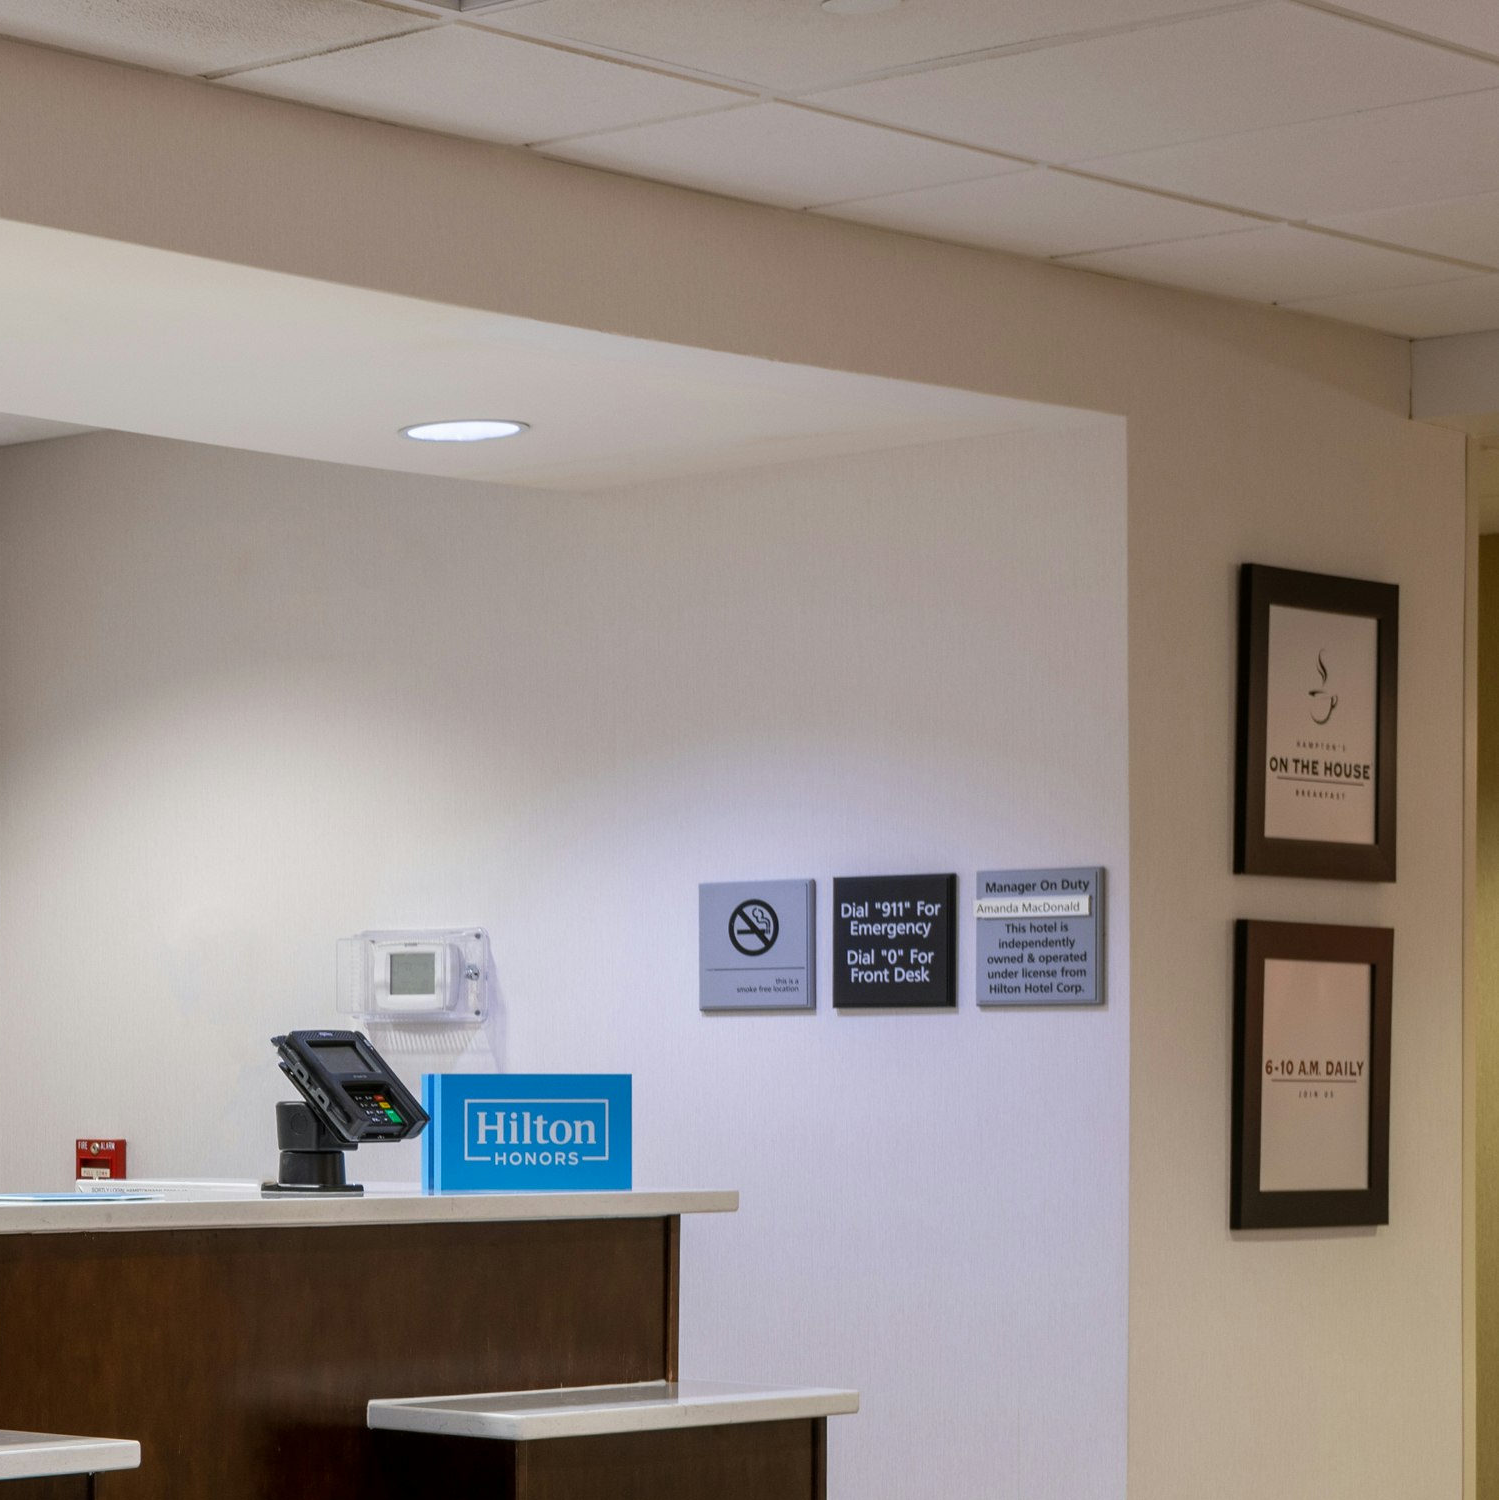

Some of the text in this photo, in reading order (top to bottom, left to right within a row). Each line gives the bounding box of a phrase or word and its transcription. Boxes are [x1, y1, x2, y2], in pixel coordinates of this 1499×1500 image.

[1269, 756, 1371, 780] ON THE HOUSE
[1295, 788, 1346, 801] BREAKFAST
[985, 879, 1090, 895] Manager On Duty
[841, 900, 941, 919] Dial "911" For
[976, 901, 1081, 914] Amanda MacDonald
[850, 920, 932, 939] Emergency
[1005, 921, 1069, 934] This hotel is
[998, 937, 1076, 951] independently
[847, 948, 934, 966] Dial "0" For
[987, 951, 1088, 965] owned & operated
[851, 965, 930, 984] Front Desk
[987, 966, 1087, 980] under license from
[775, 977, 787, 985] this
[773, 985, 800, 993] location
[989, 982, 1085, 996] Hilton Hotel Corp.
[1265, 1059, 1364, 1076] 6-10 A.M. DAILY
[476, 1111, 596, 1145] Hilton
[78, 1141, 116, 1150] FIRE ALARM
[494, 1151, 579, 1166] HONORS
